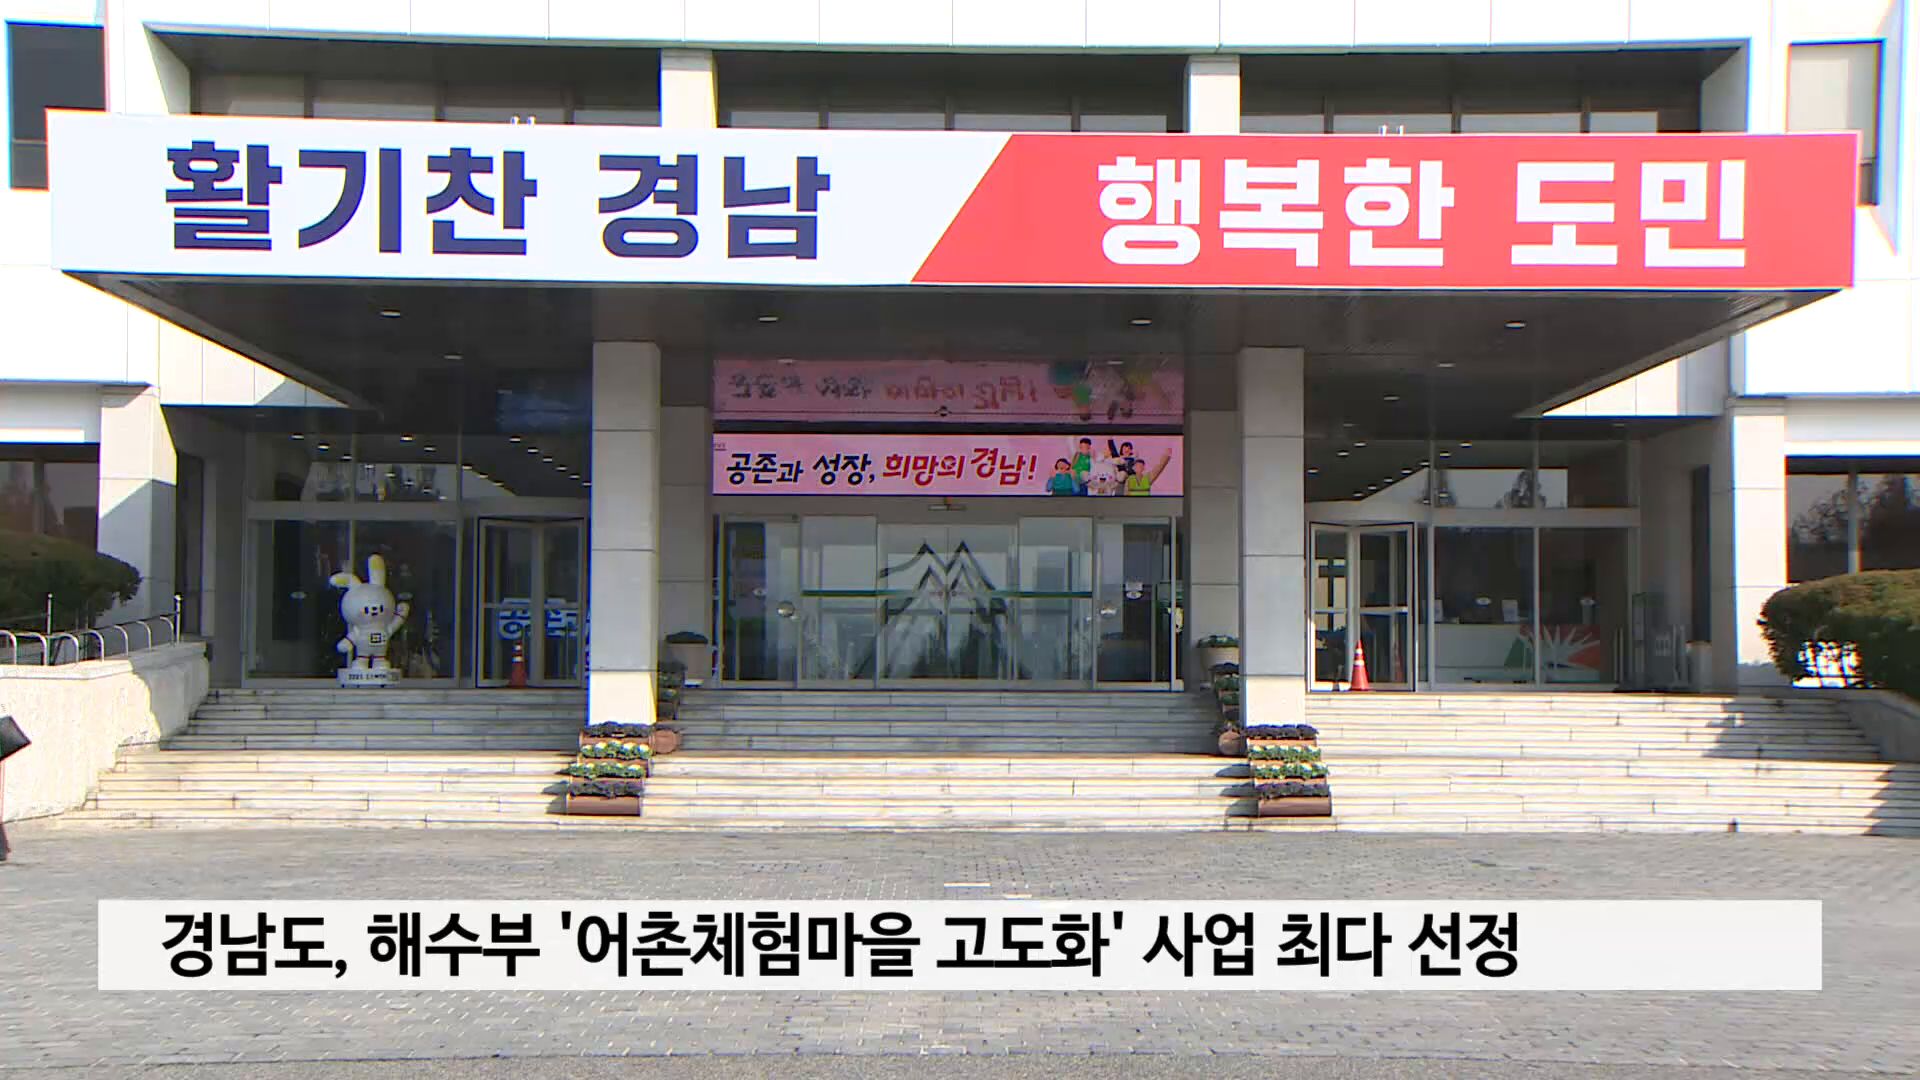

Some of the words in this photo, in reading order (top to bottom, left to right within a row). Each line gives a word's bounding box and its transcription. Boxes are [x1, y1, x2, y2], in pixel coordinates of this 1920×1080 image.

[166, 141, 538, 255] 활기찬
[599, 154, 830, 260] 경남
[1097, 155, 1456, 268] 행복한
[1509, 159, 1748, 269] 도민
[726, 452, 805, 486] 공존과
[812, 453, 876, 486] 성장,
[883, 453, 966, 487] 희망의
[970, 447, 1038, 487] 경남!
